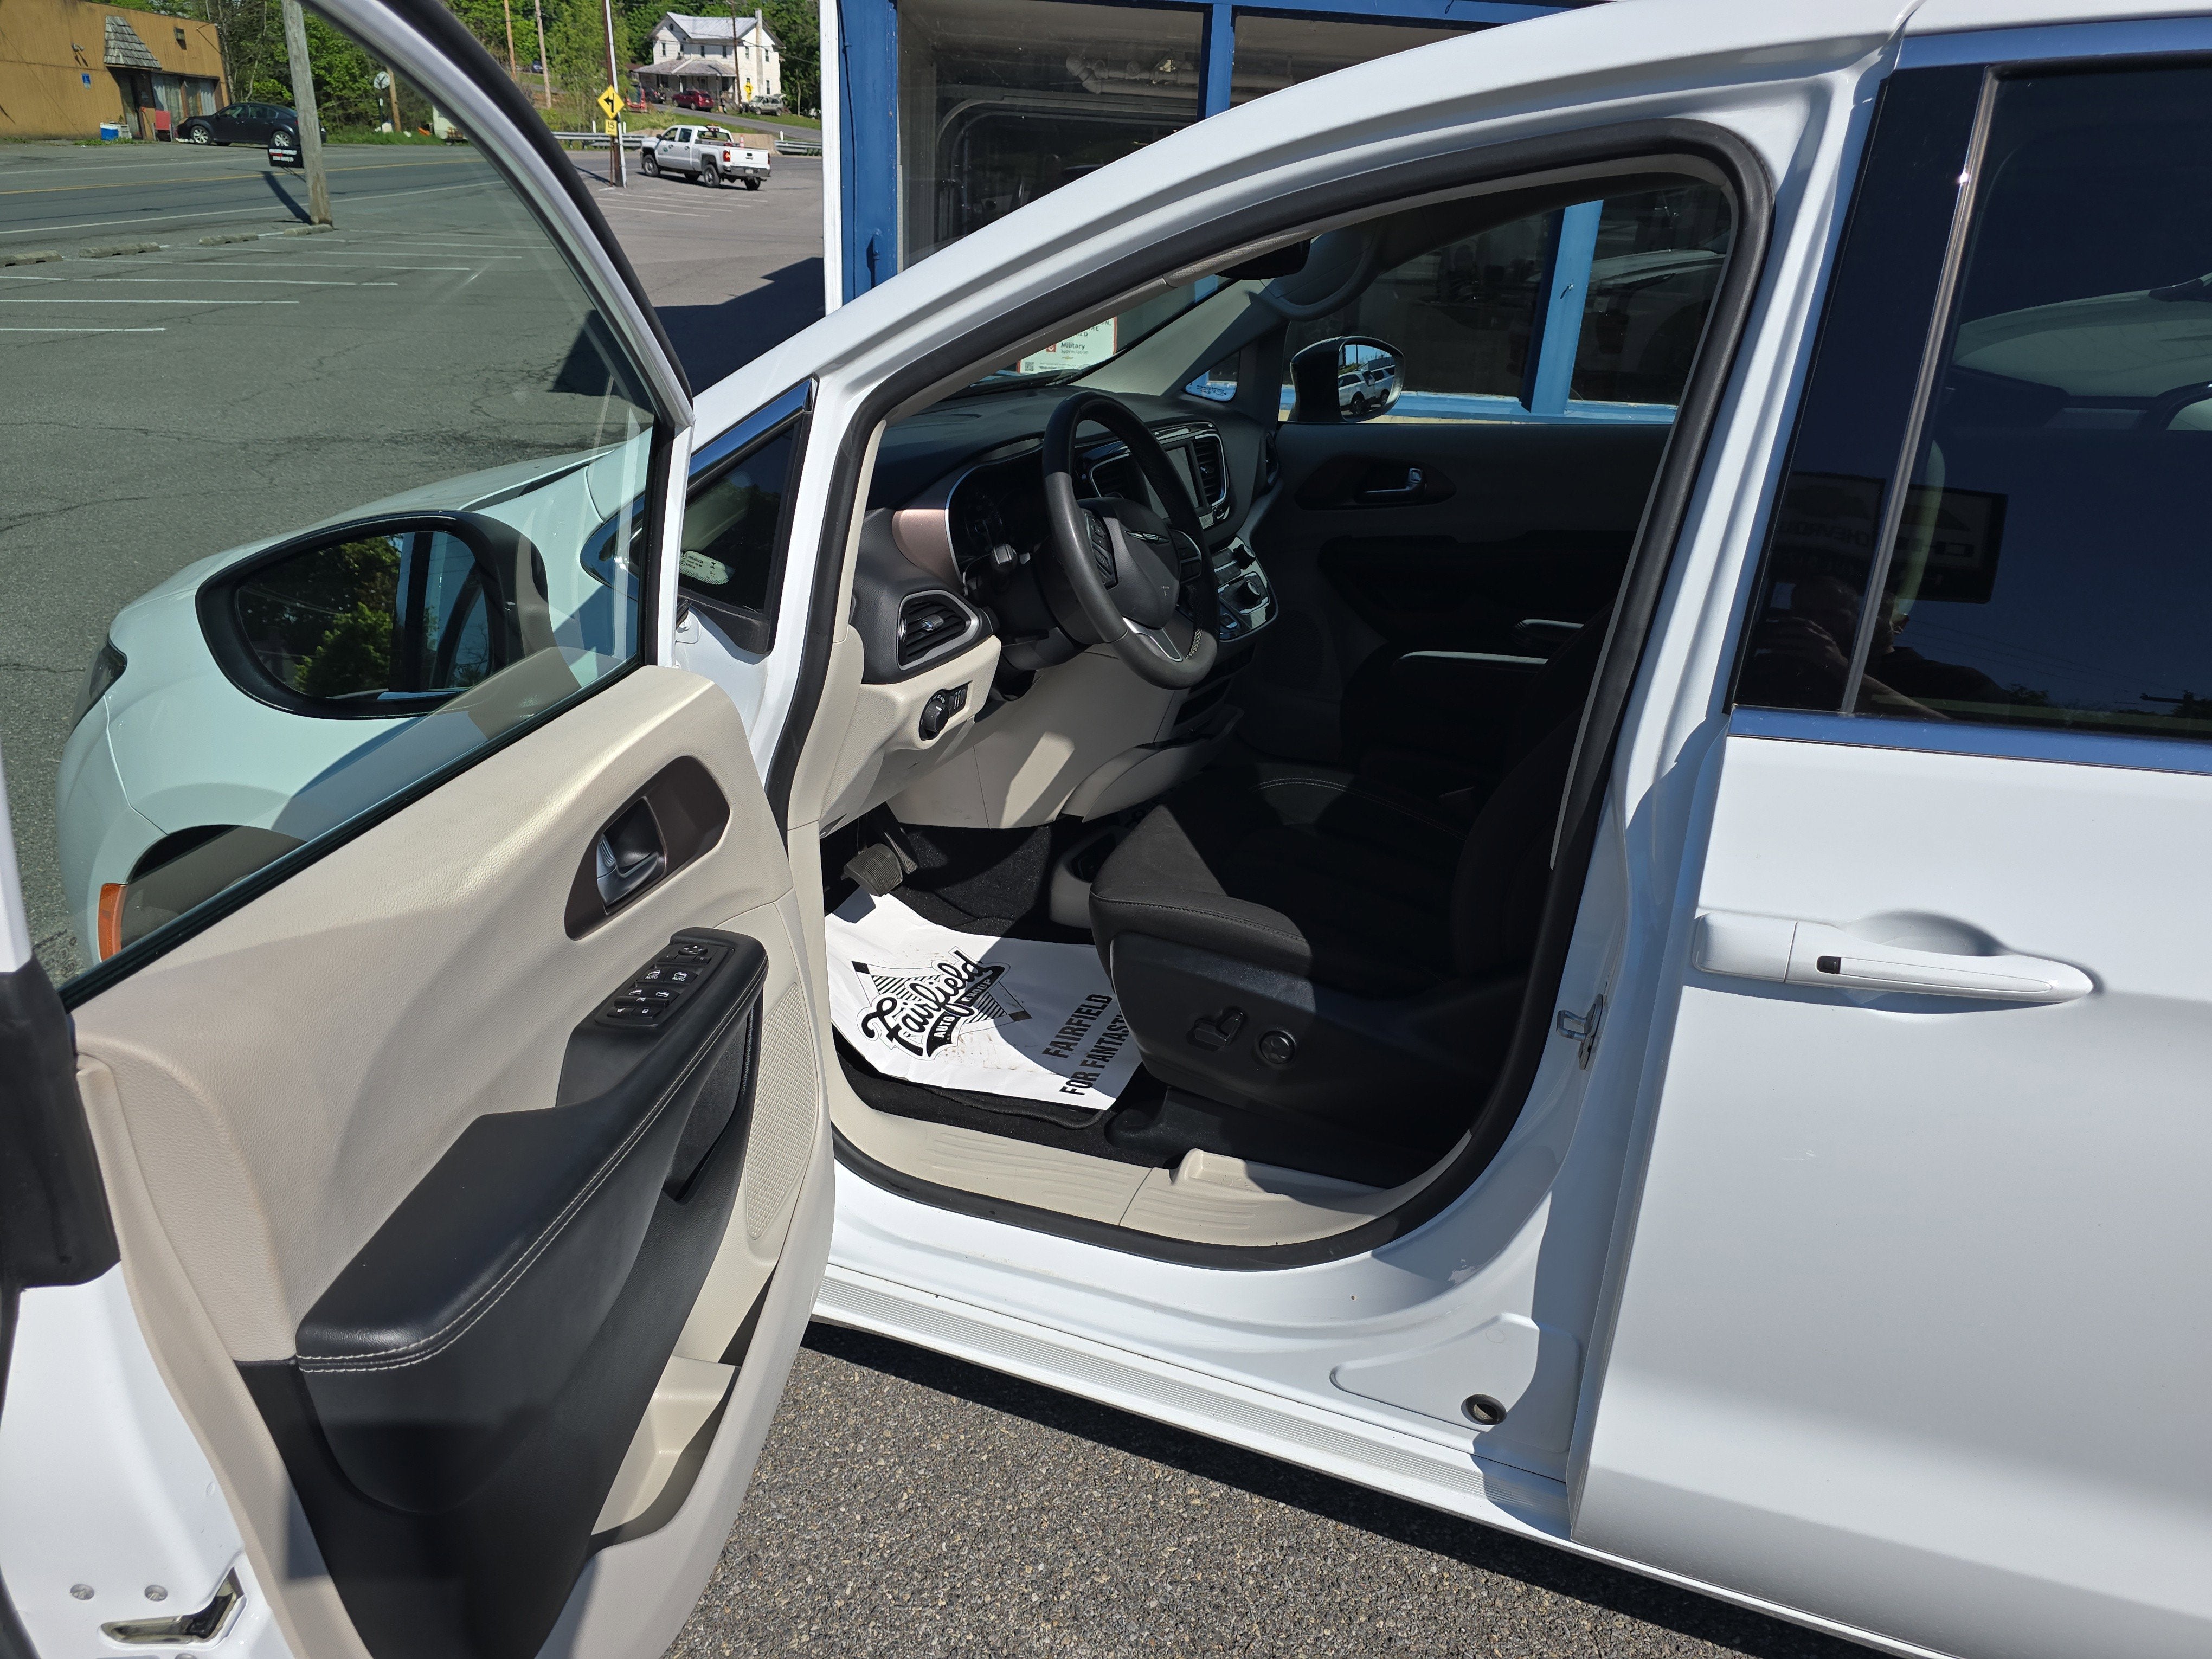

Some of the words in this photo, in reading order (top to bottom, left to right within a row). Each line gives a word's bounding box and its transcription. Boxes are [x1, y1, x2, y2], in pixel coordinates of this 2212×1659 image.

[608, 121, 615, 129] 15
[861, 950, 1005, 1056] Fairfield
[934, 1015, 955, 1038] AUTO
[963, 979, 991, 1002] GROUP
[1041, 994, 1113, 1058] FAIRFIELD
[1079, 1011, 1129, 1069] FANTAST
[1059, 1071, 1101, 1095] FOR
